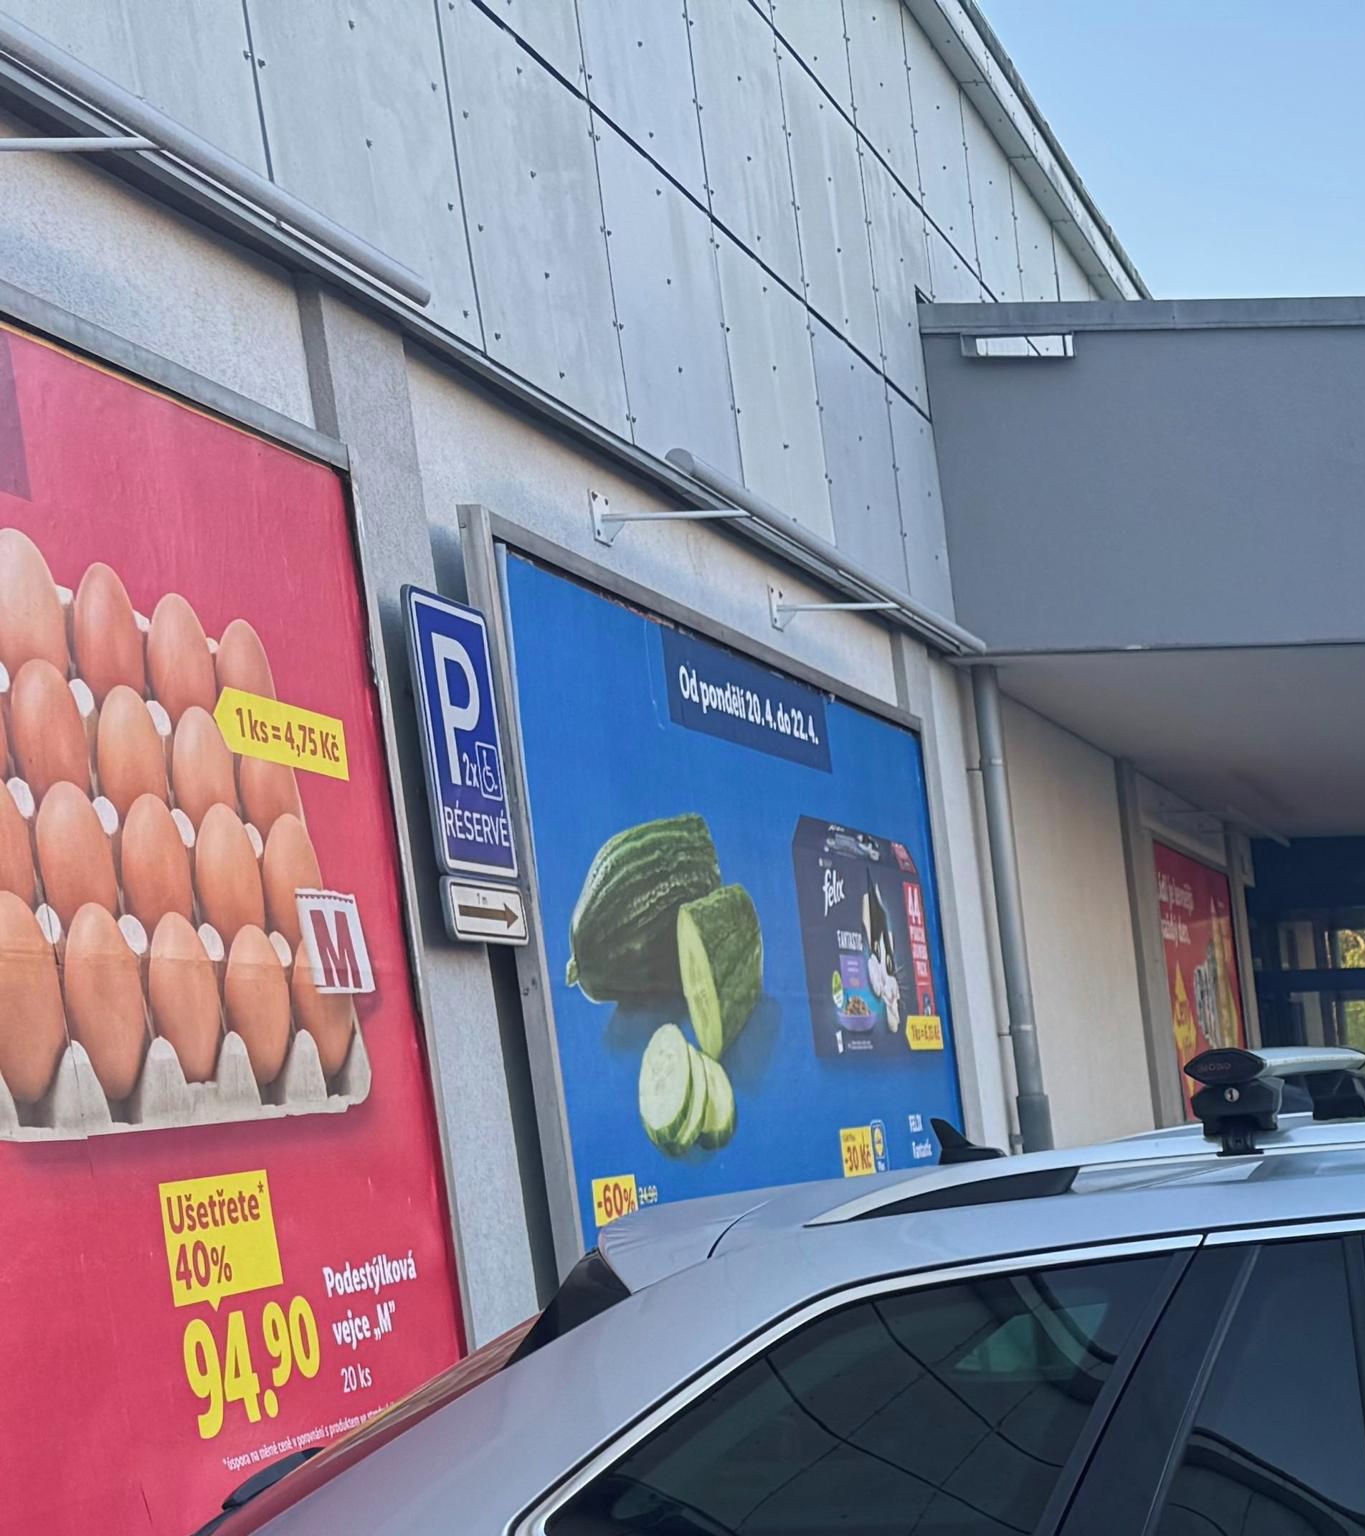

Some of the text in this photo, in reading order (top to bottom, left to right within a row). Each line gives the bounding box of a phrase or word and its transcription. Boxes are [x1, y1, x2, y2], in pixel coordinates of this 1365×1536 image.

[431, 632, 480, 785] P
[679, 665, 699, 703] Od
[700, 681, 746, 719] pondělí
[777, 702, 791, 735] do
[235, 707, 340, 762] 1 ks = 4,75 Kč
[462, 752, 480, 789] 2x
[444, 800, 510, 847] RÉSERVÉ
[822, 869, 845, 917] felix
[908, 886, 921, 925] 44
[309, 909, 363, 988] M
[597, 1182, 636, 1218] -60%
[175, 1240, 232, 1290] 40%
[322, 1250, 417, 1298] Podestýlková
[332, 1310, 371, 1350] vejce
[184, 1296, 320, 1439] 94.90
[341, 1364, 372, 1393] 20 ks
